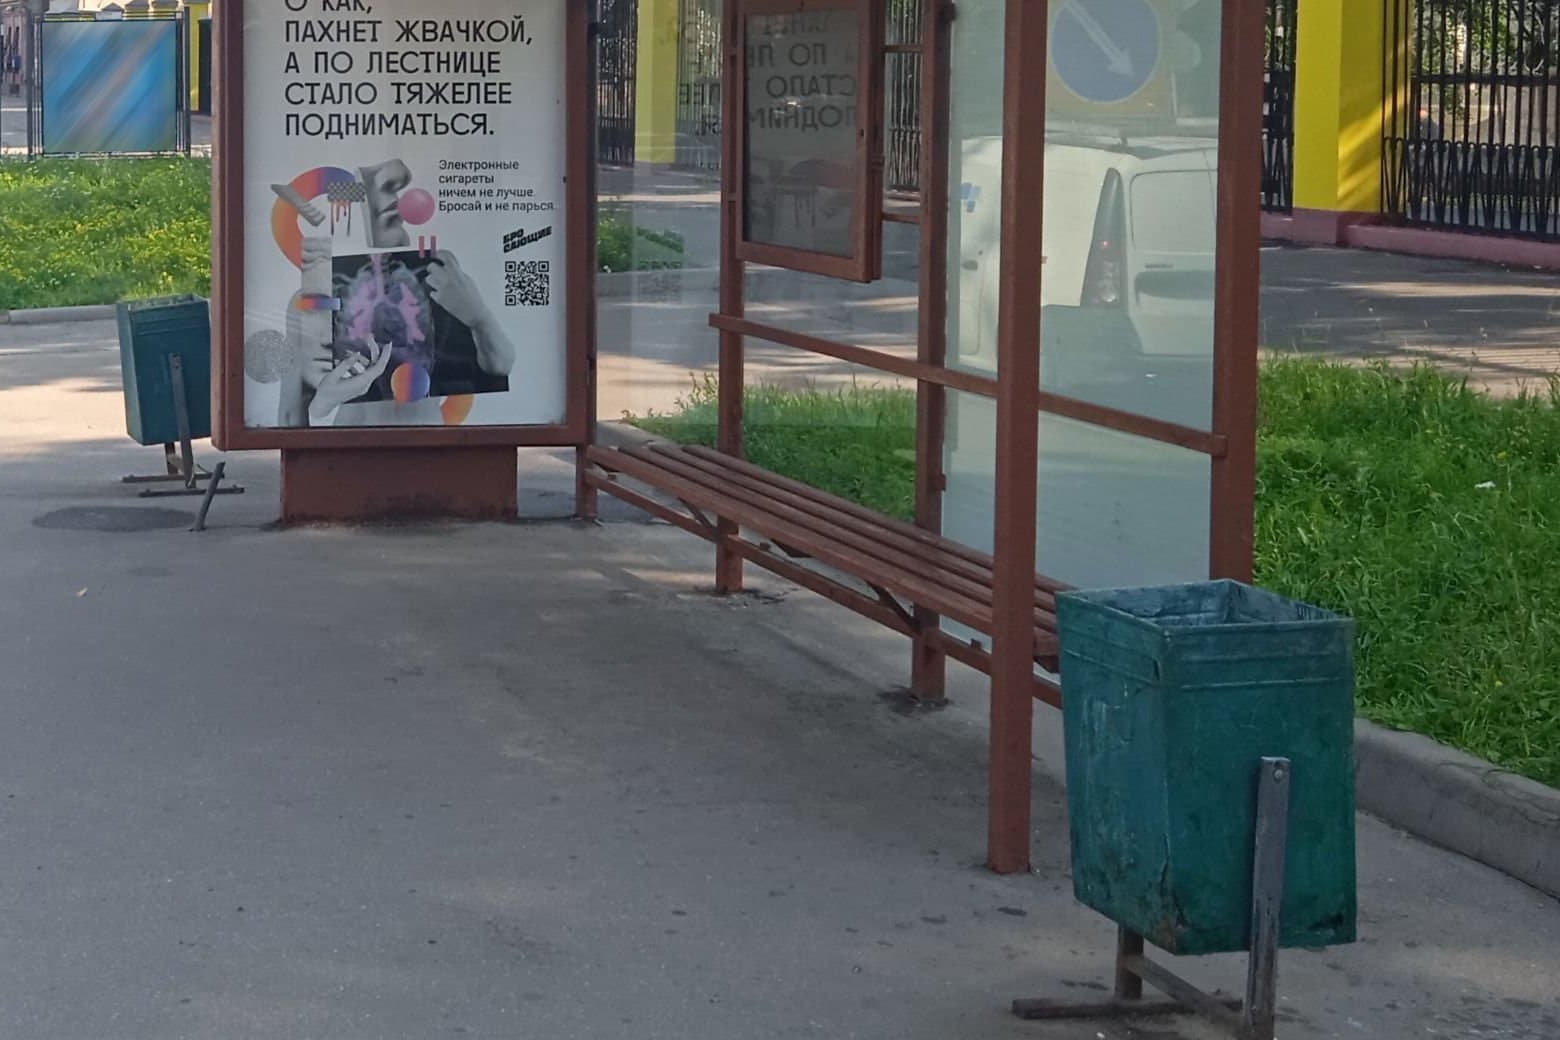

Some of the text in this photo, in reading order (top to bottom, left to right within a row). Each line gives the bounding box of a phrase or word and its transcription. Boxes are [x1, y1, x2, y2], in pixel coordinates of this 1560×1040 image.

[285, 15, 533, 46] ПАХНЕТ ЖВАЧКОЙ,
[284, 51, 501, 77] А ПО ЛЕСТНИЦЕ
[284, 82, 512, 105] СТАЛО ТЯЖЕЛЕЕ
[285, 112, 495, 140] ПОДНИМАТЬСЯ.
[439, 160, 519, 172] Электронные
[438, 175, 494, 185] сигареты
[439, 189, 476, 197] ничем
[480, 189, 494, 197] не
[439, 200, 481, 213] Бросай
